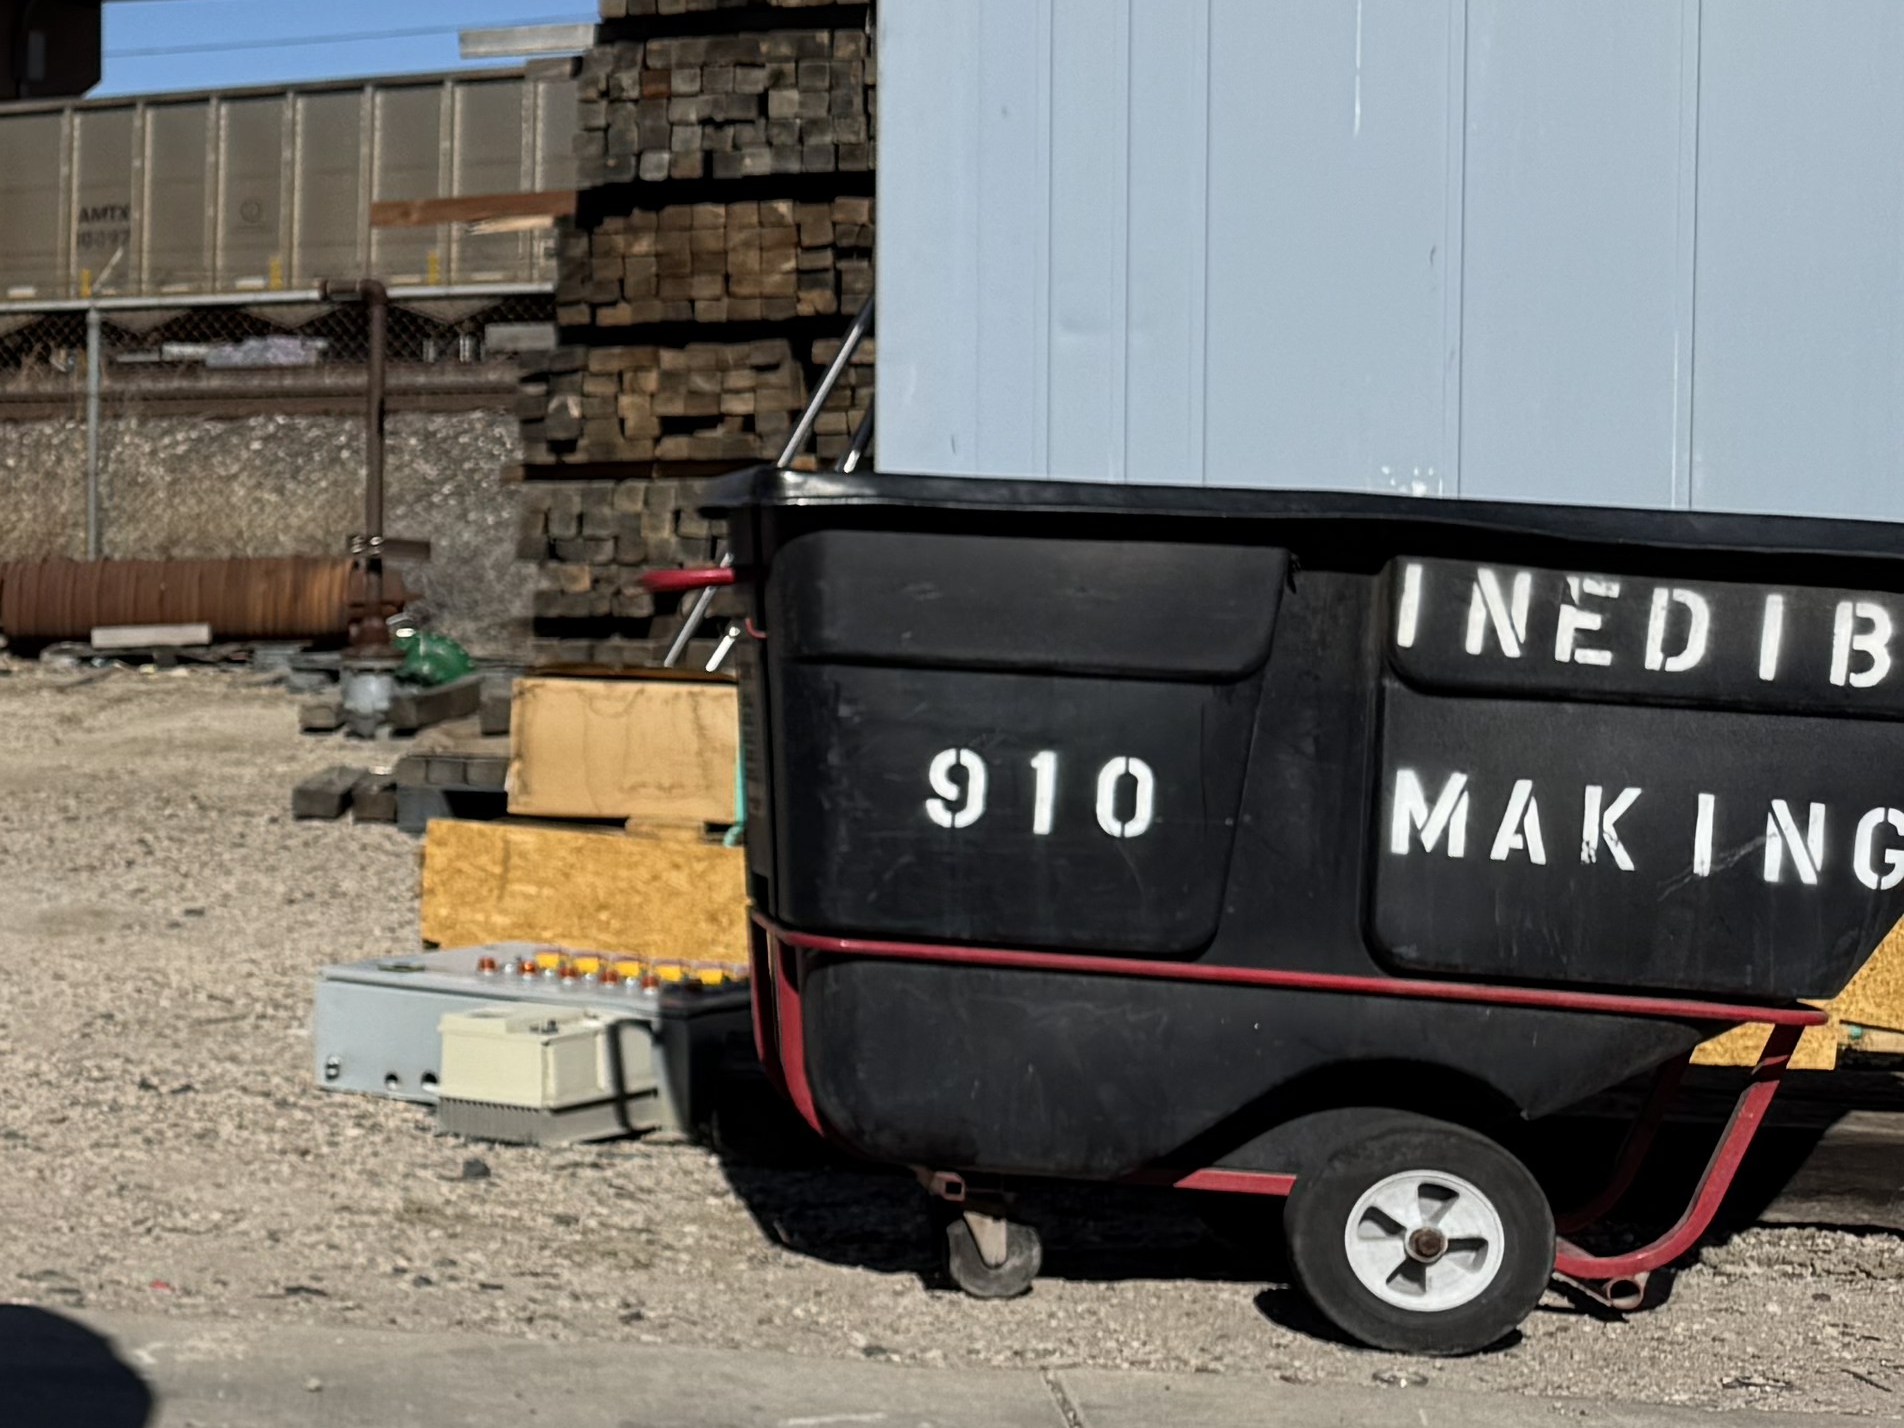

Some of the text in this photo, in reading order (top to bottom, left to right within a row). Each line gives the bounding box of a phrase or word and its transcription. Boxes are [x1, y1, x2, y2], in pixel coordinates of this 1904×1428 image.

[1396, 563, 1893, 689] INEDIB
[925, 747, 1154, 839] 910
[1391, 768, 1904, 891] MAKING
